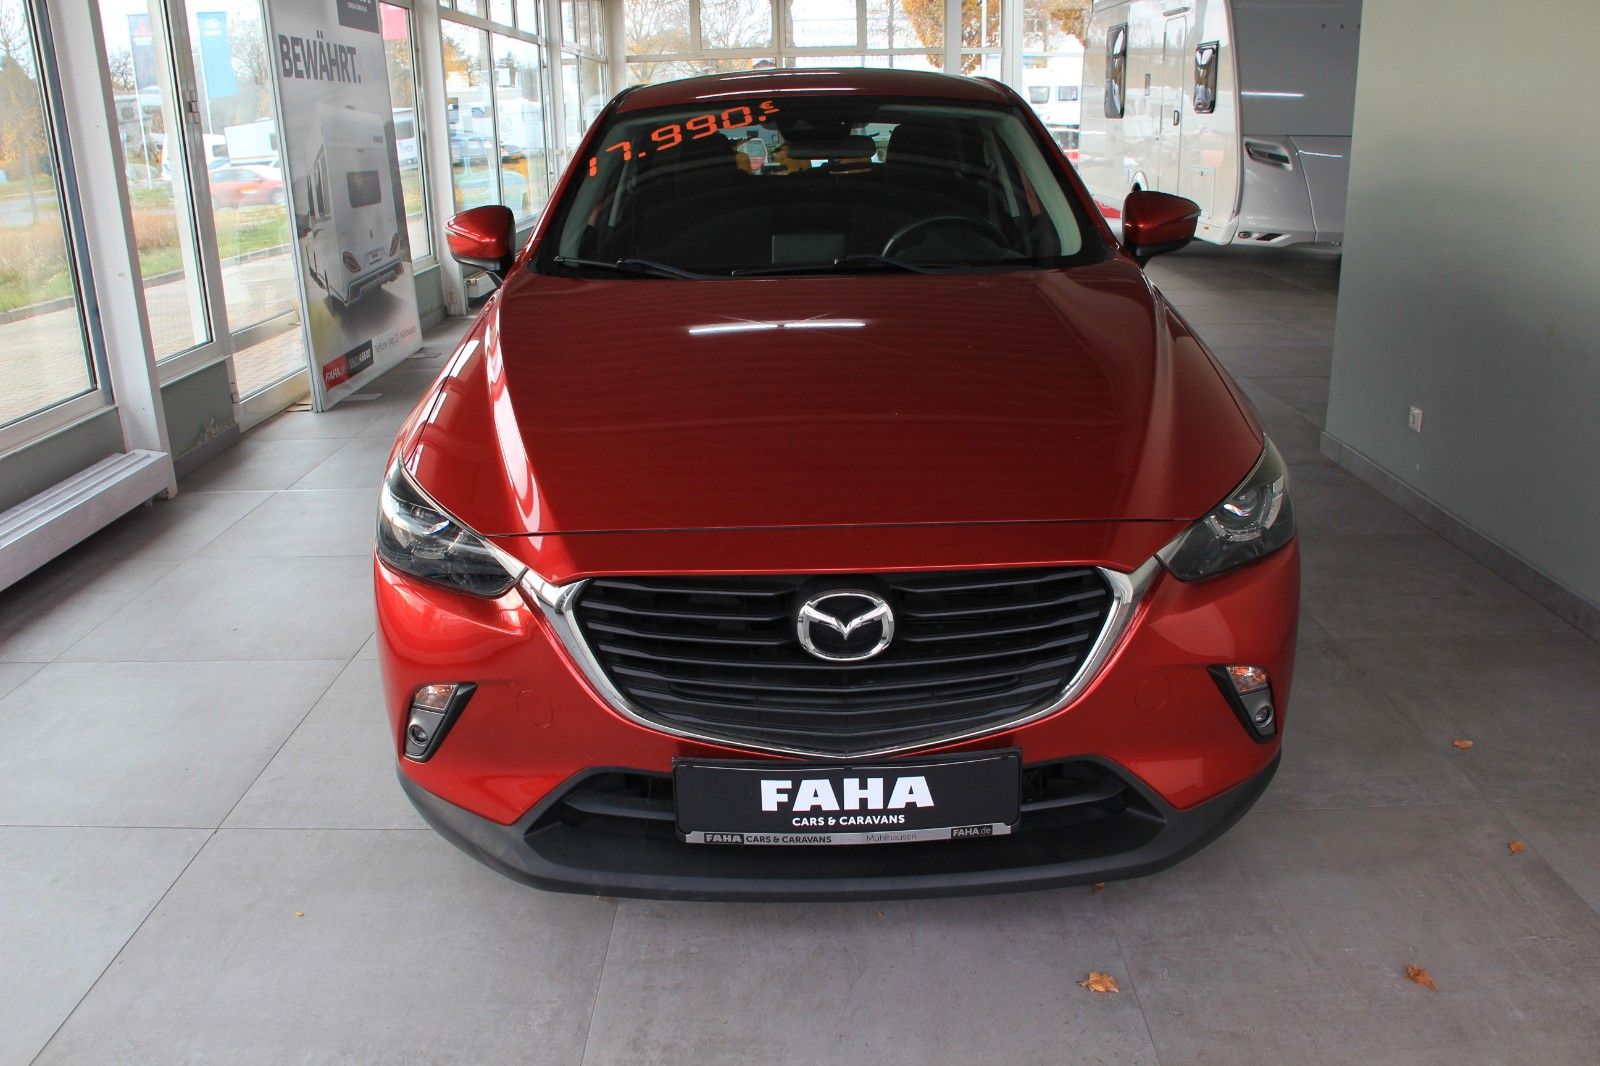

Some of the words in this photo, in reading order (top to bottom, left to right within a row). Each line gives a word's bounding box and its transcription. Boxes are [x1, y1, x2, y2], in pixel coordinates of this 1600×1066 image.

[279, 30, 361, 83] BEWÄHRT.
[760, 775, 935, 812] FAHA
[792, 816, 825, 827] CARS
[827, 816, 837, 826] &
[839, 814, 906, 826] CARAVANS
[705, 833, 743, 843] FAHA
[745, 835, 772, 844] CARS
[772, 835, 780, 843] &
[781, 835, 832, 844] CARAVANS
[952, 826, 992, 837] FAHA.de
